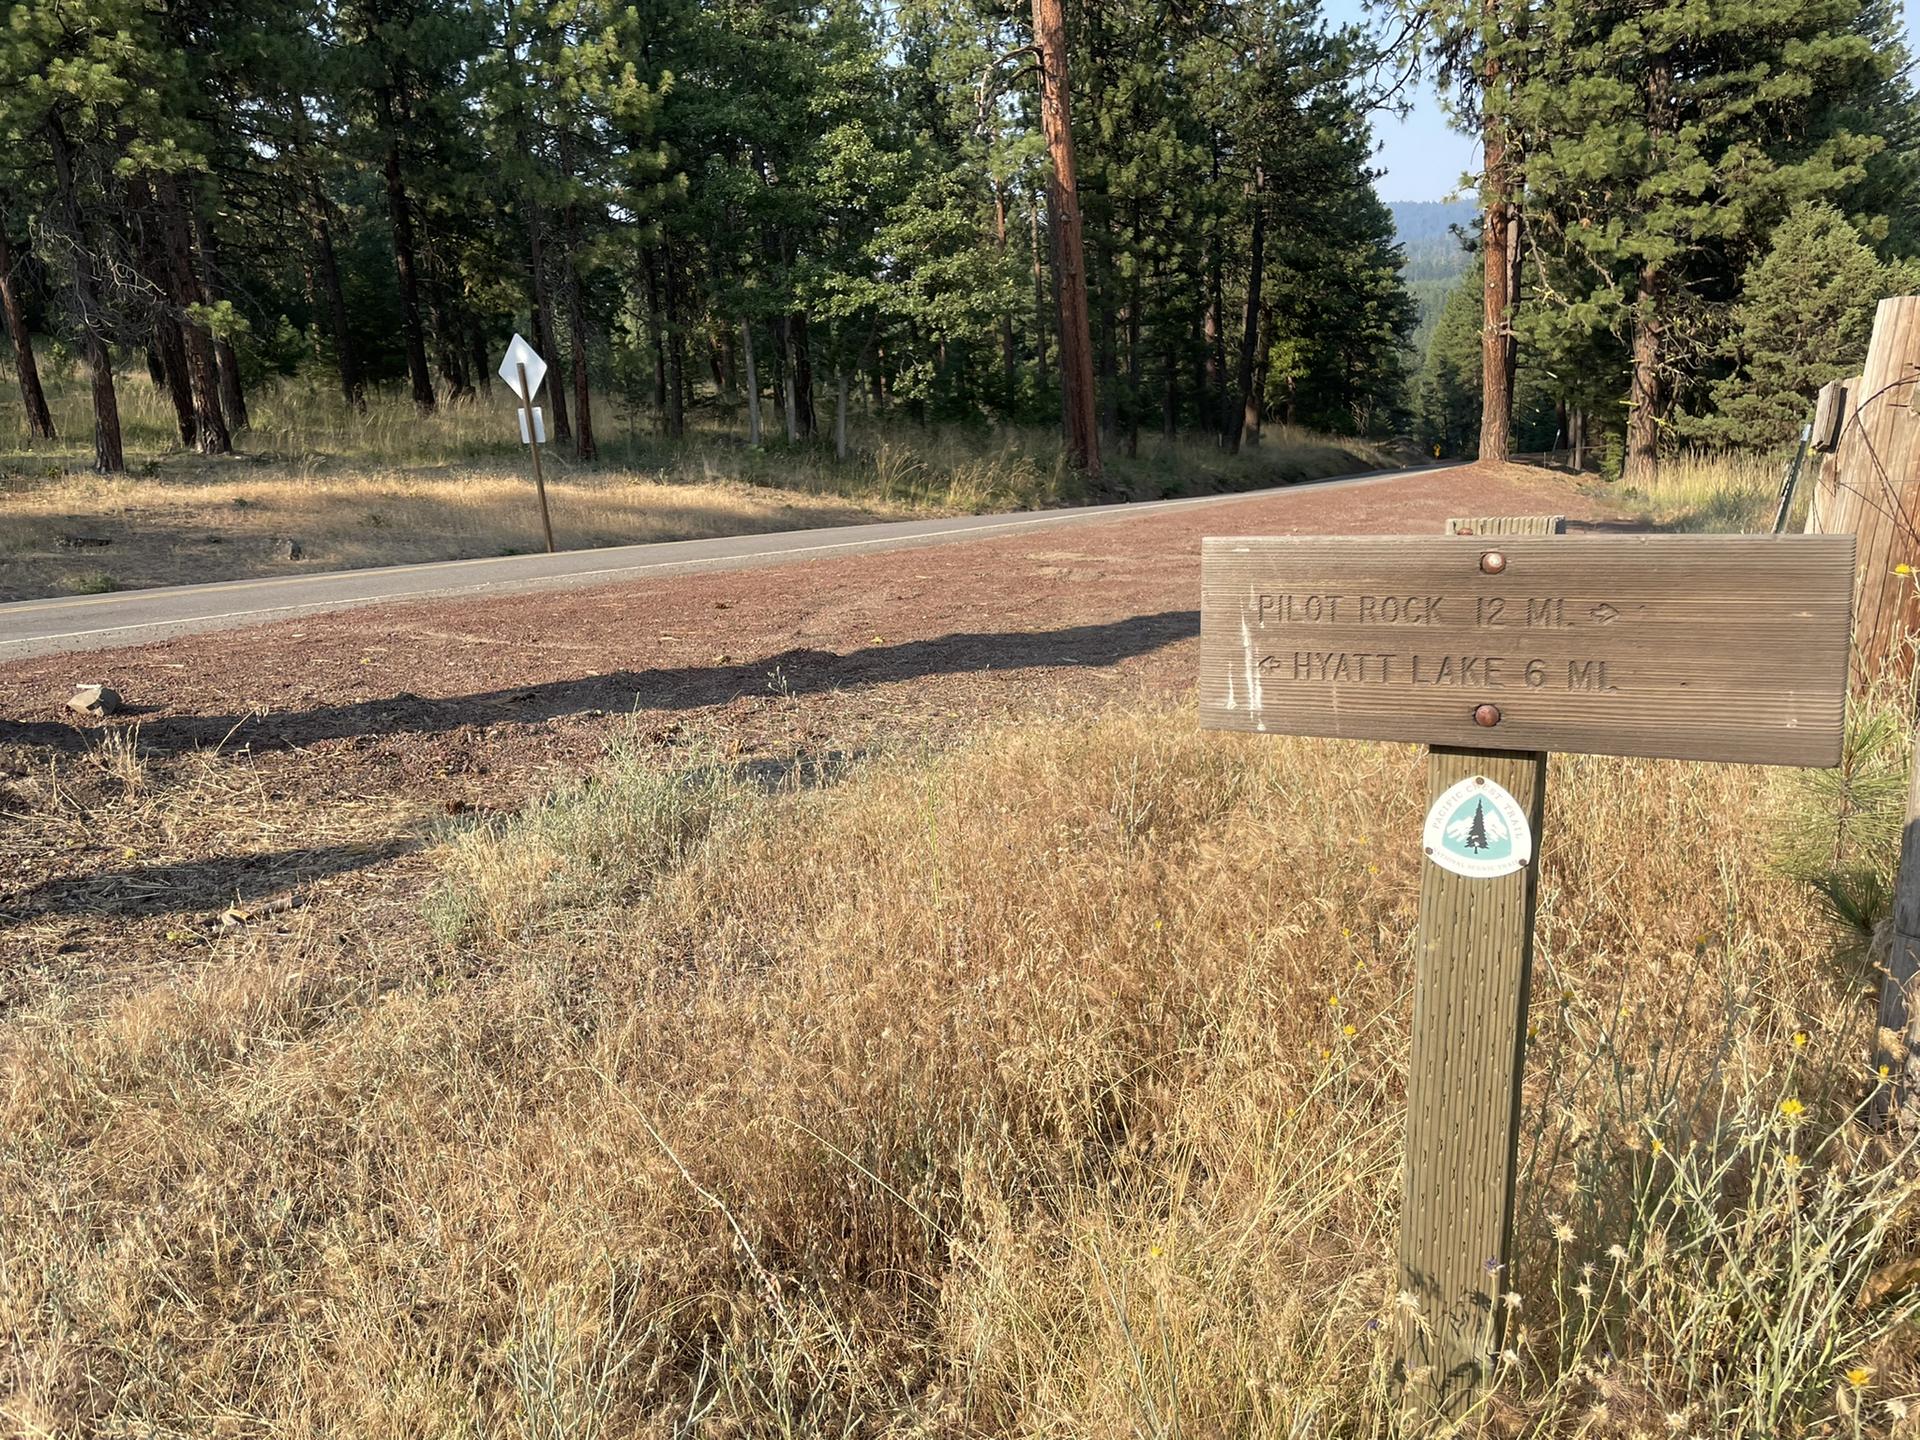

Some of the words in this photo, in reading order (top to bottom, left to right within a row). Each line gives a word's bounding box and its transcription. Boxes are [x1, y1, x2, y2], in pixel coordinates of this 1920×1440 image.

[1257, 594, 1343, 624] PILOT
[1359, 595, 1443, 625] ROCK
[1475, 597, 1506, 628] 12
[1292, 651, 1397, 684] HYATT
[1412, 655, 1505, 687] LAKE
[1523, 658, 1547, 690] 6
[1432, 791, 1463, 830] PACIFIC
[1503, 803, 1523, 839] TRAIL
